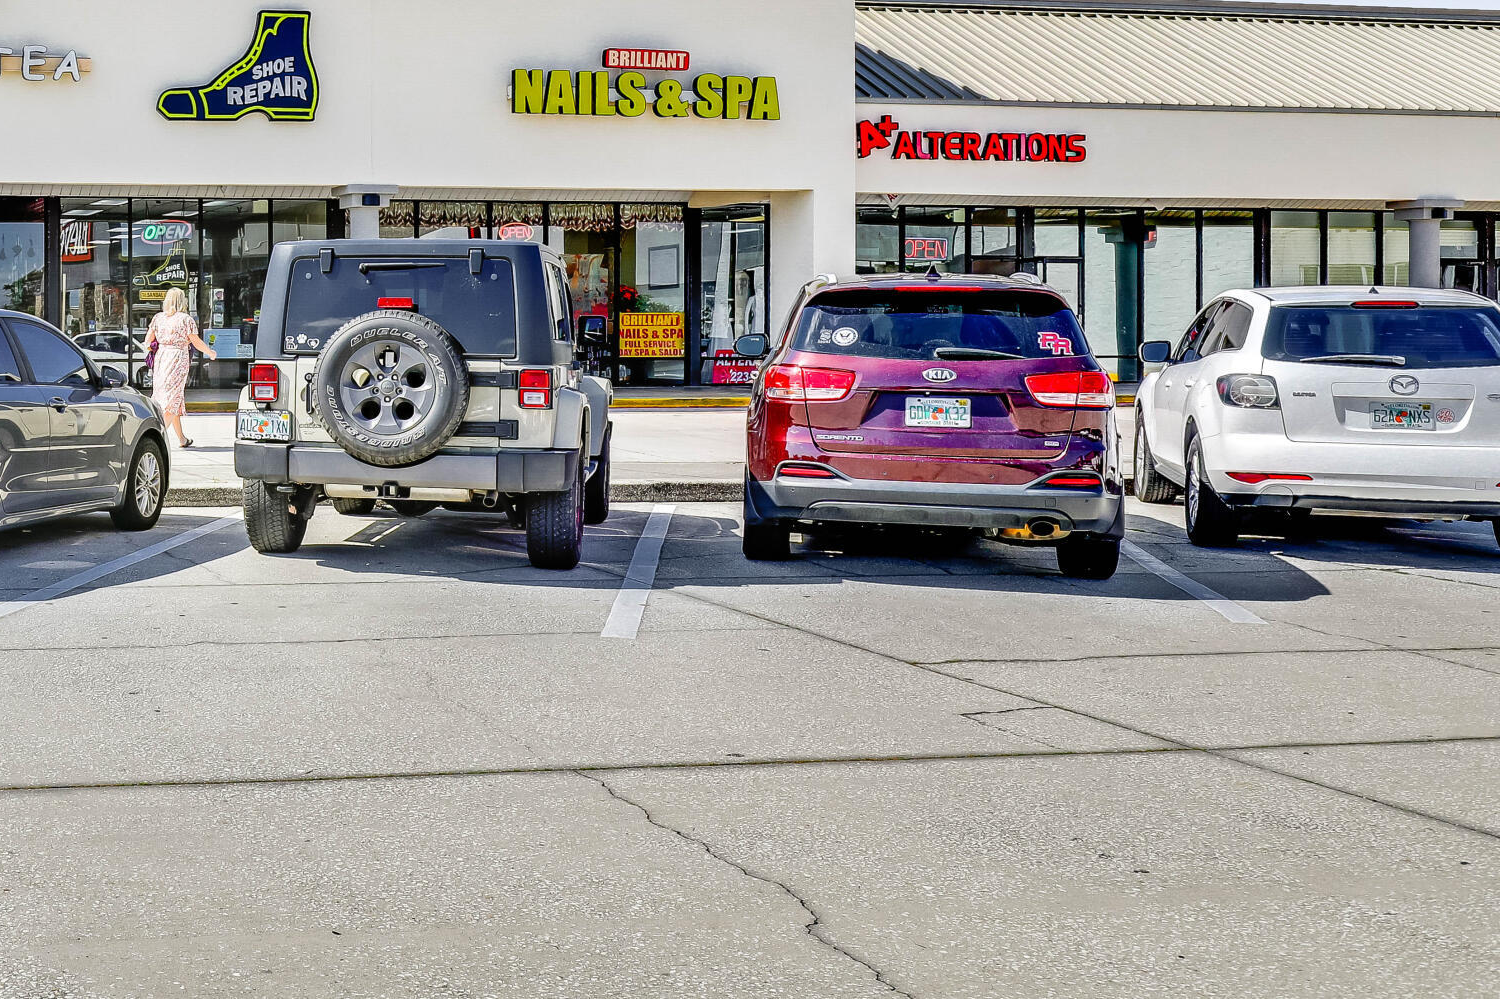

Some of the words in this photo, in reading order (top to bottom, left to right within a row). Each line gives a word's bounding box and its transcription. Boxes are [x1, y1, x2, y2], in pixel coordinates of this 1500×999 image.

[608, 50, 687, 70] BRILLIANT
[251, 56, 295, 80] SHOE
[226, 75, 308, 106] REPAIR
[511, 69, 647, 117] NAILS
[654, 78, 690, 118] &
[693, 73, 781, 120] SPA
[891, 131, 1087, 163] ALTERATIONS
[143, 224, 186, 240] OPEN
[503, 226, 531, 239] OPEN
[905, 239, 947, 259] OPEN
[156, 270, 185, 281] REPAIR
[165, 263, 181, 273] SHOE
[623, 314, 679, 326] BRILLIANT
[350, 327, 430, 350] DUELER
[619, 328, 649, 339] NAILS
[651, 329, 660, 339] &
[662, 328, 684, 339] SPA
[624, 340, 641, 348] FULL
[643, 340, 677, 348] SERVICE
[634, 348, 650, 356] SPA
[928, 370, 951, 380] KIA
[326, 384, 426, 448] BRIDGESTONE
[944, 406, 967, 420] K32
[1373, 409, 1395, 423] 62A
[1408, 410, 1431, 424] NXS
[240, 418, 259, 432] AU2
[271, 420, 288, 434] 1XN
